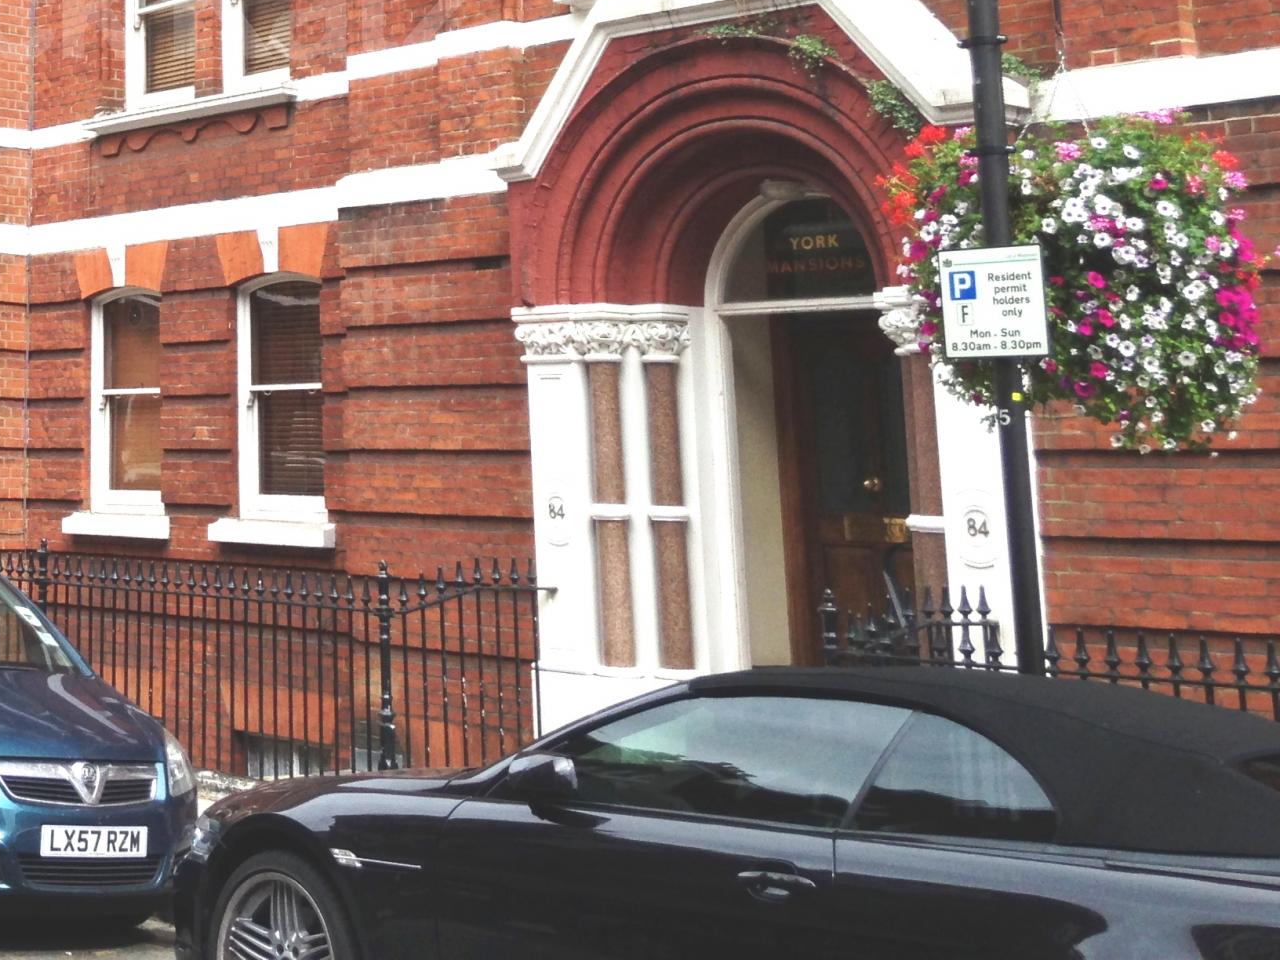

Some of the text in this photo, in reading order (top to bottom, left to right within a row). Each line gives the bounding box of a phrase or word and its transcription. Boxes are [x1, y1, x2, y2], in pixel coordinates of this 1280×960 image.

[789, 233, 840, 250] YORK
[767, 255, 866, 273] MANSIONS
[987, 271, 1032, 282] Resident
[994, 284, 1028, 295] permit
[992, 296, 1031, 306] holders
[961, 305, 969, 323] F
[1001, 307, 1023, 318] only
[970, 329, 992, 339] Mon
[1000, 327, 1021, 338] Sun
[951, 341, 992, 352] 8.30am
[1000, 340, 1042, 351] 8.30pm
[548, 502, 565, 520] 84
[966, 517, 990, 538] 84
[50, 829, 140, 853] LX57 RZM
